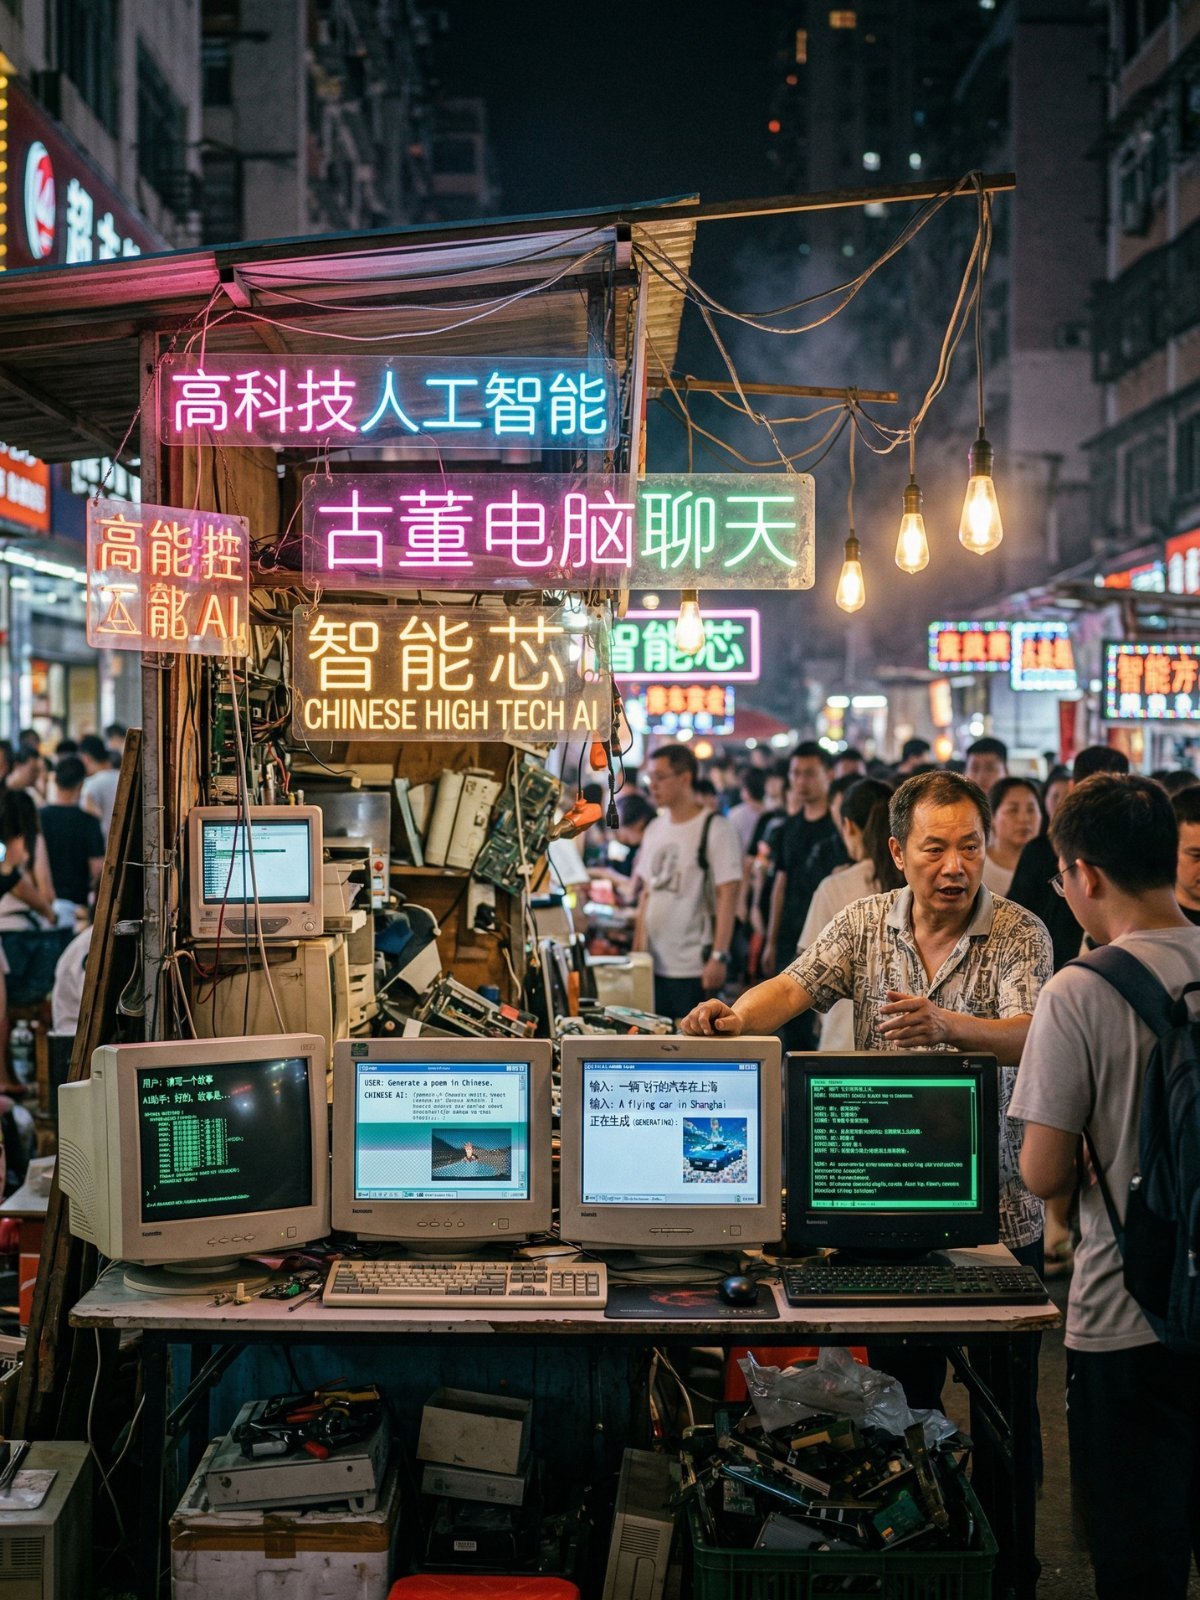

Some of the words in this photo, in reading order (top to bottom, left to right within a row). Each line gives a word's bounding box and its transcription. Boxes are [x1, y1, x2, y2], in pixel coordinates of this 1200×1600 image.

[172, 369, 607, 436] 高科技人工智能
[318, 489, 797, 570] 古董电脑聊天
[308, 615, 564, 692] 智能芯
[1117, 653, 1200, 695] 智能方
[304, 698, 417, 731] CHINESE
[425, 698, 489, 731] HIGH
[496, 698, 564, 731] TECH
[573, 699, 598, 731] AI
[364, 1079, 384, 1087] USER:
[387, 1079, 420, 1087] Generate
[430, 1080, 448, 1089] poem
[451, 1079, 459, 1087] in
[461, 1079, 493, 1087] Chinese.
[364, 1091, 393, 1099] CHINESE
[395, 1091, 408, 1099] AI:
[590, 1115, 630, 1127] 正在生成
[618, 1099, 625, 1109] A
[628, 1099, 655, 1111] flying
[659, 1101, 673, 1109] car
[678, 1099, 687, 1109] in
[690, 1099, 727, 1111] Shanghai
